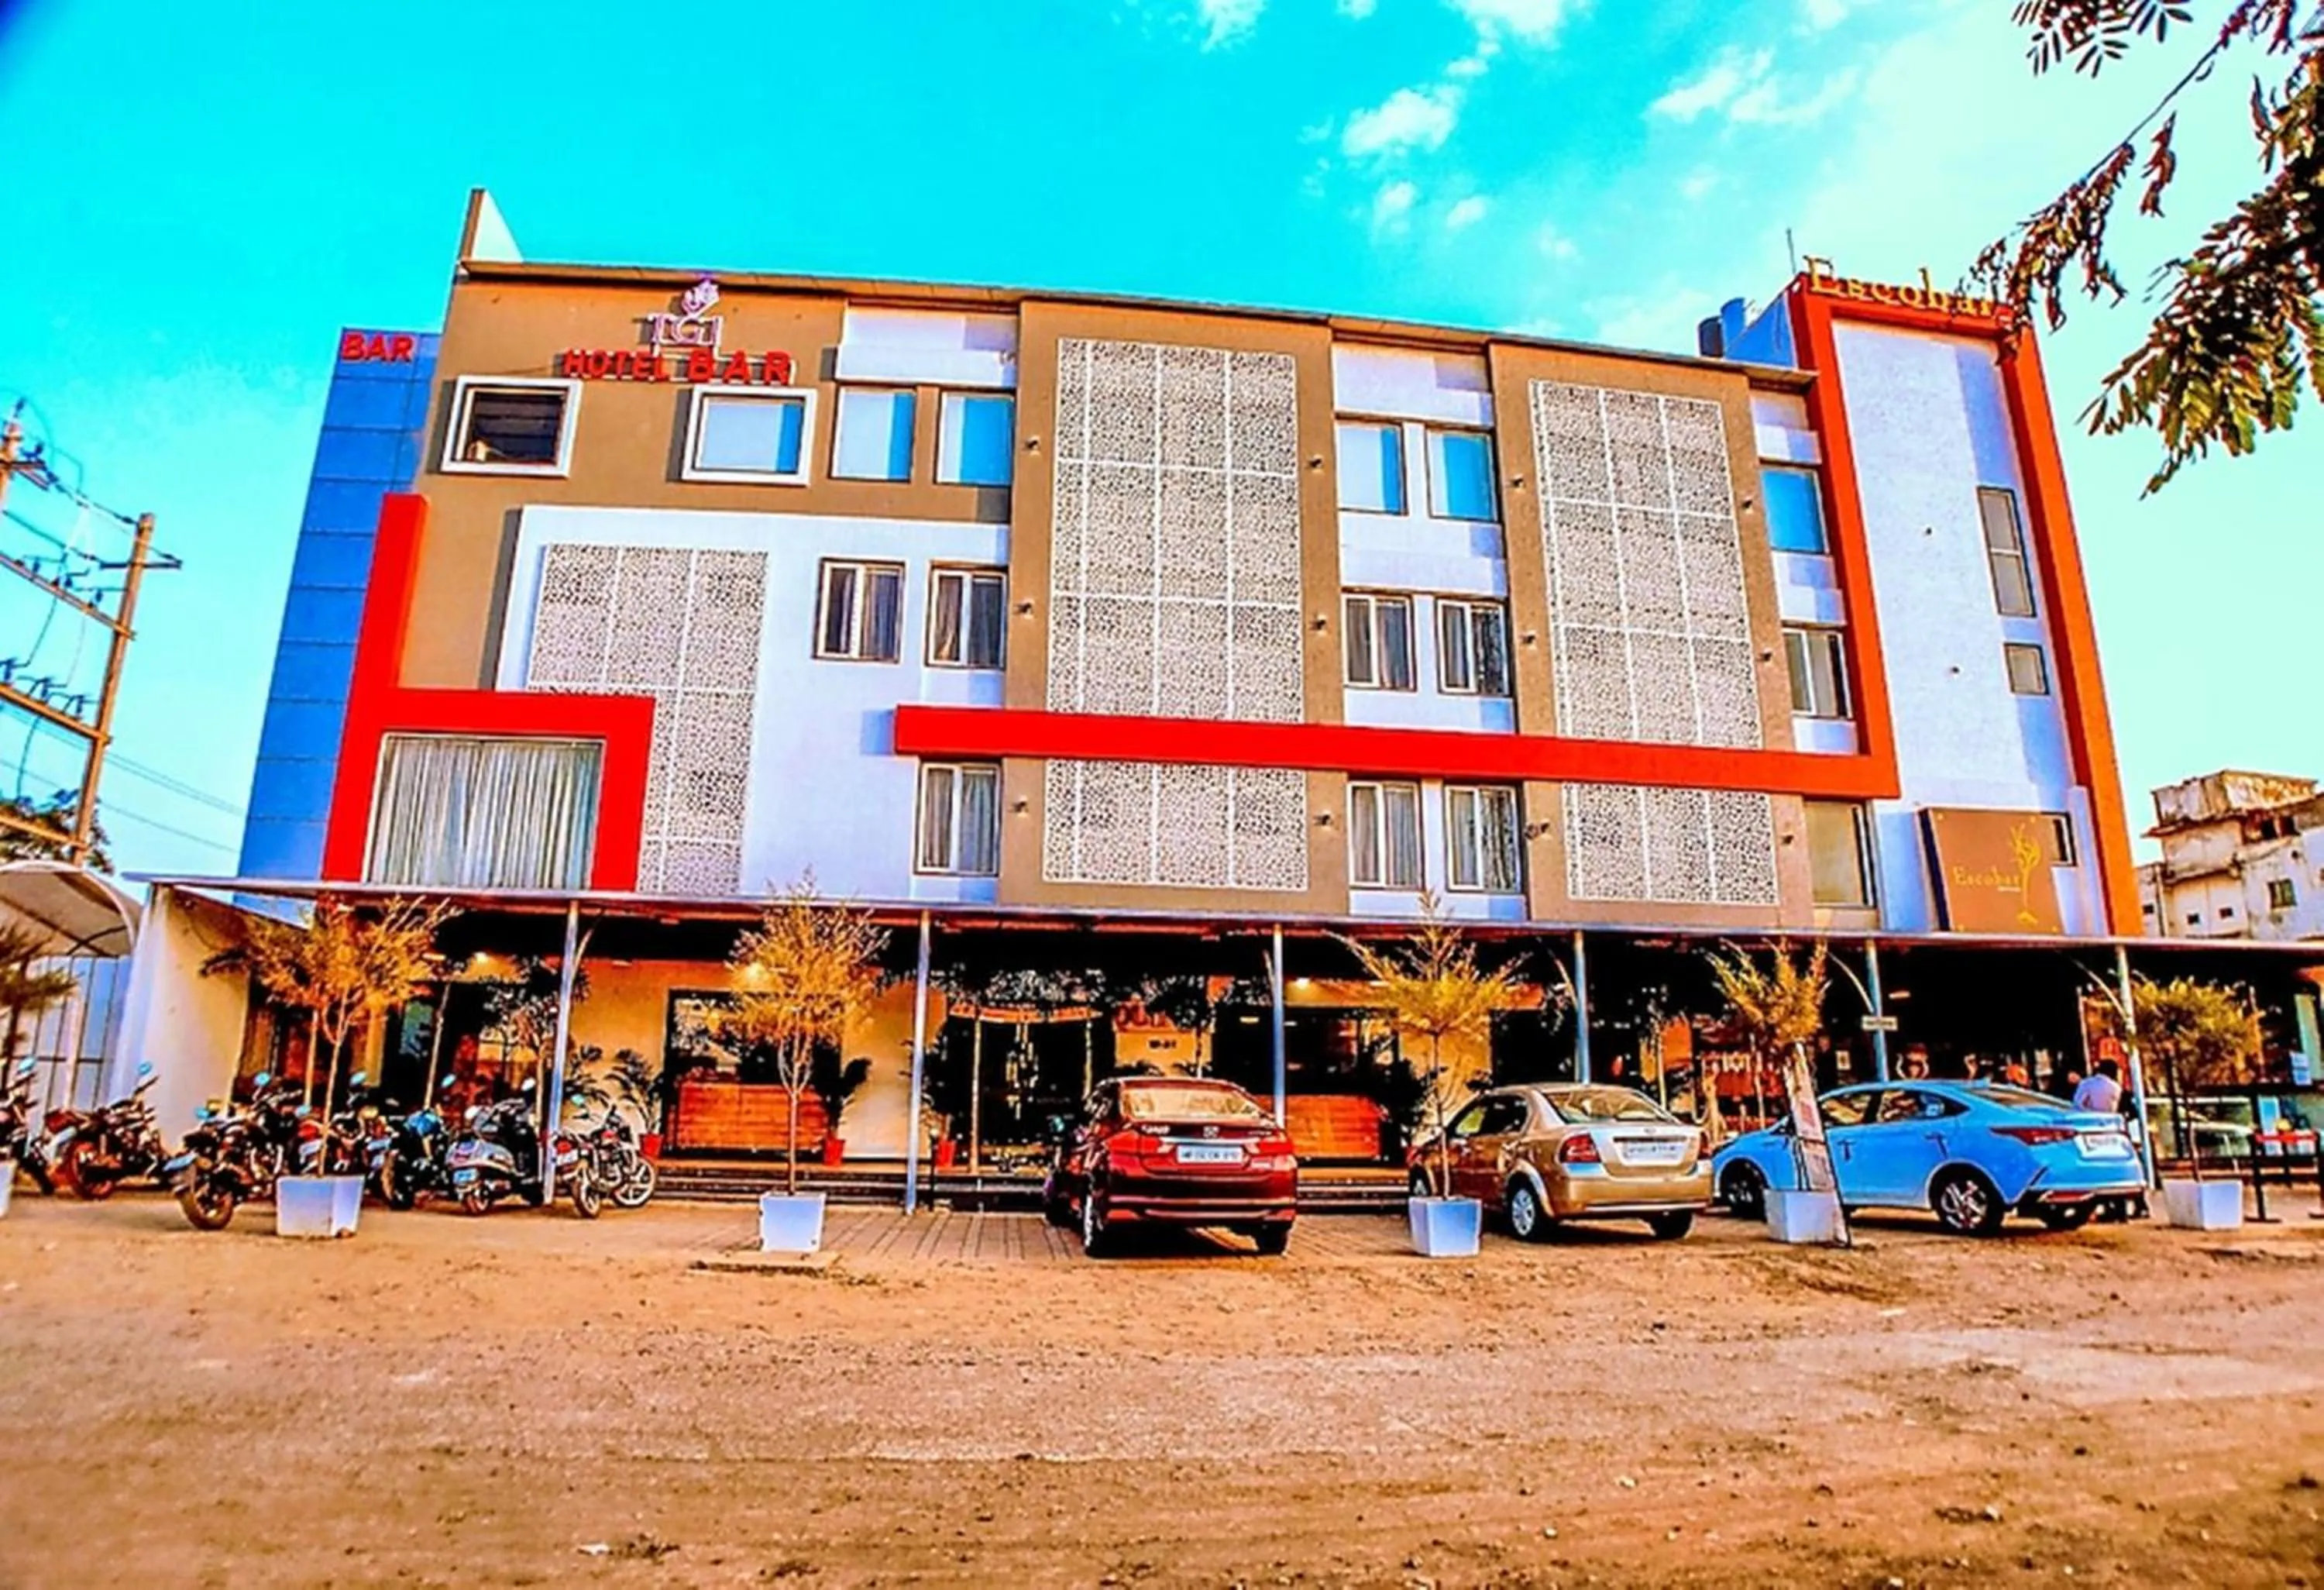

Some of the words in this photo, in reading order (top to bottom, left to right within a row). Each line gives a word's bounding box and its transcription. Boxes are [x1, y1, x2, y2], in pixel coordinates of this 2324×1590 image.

[342, 331, 416, 363] BAR
[563, 348, 669, 380] HOTEL
[686, 347, 791, 385] BAR
